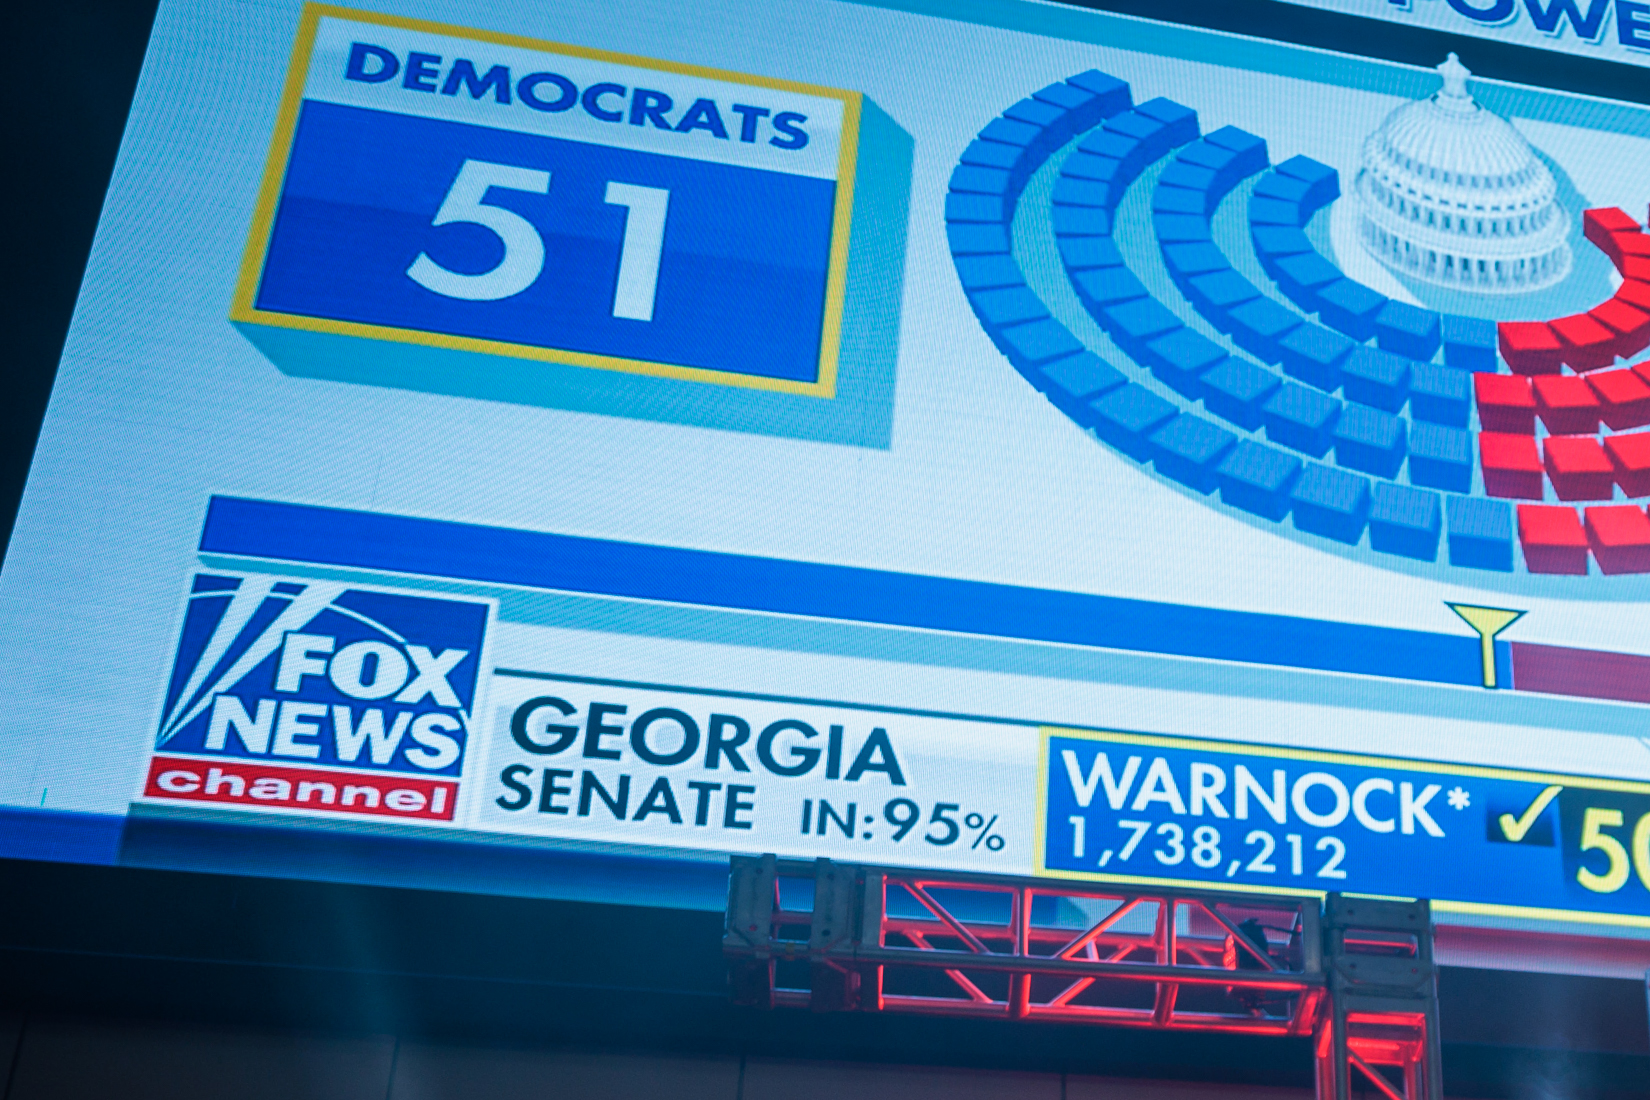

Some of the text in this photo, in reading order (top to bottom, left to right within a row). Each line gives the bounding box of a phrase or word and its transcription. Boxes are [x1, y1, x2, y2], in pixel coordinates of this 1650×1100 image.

[344, 41, 810, 150] DEMOCRATS
[406, 158, 672, 322] 51
[273, 631, 469, 708] FOX
[205, 694, 467, 771] NEWS
[510, 695, 906, 786] GEORGIA
[156, 766, 448, 815] channel
[495, 762, 1006, 853] SENATE IN:95%
[1068, 816, 1348, 879] 1,738,212
